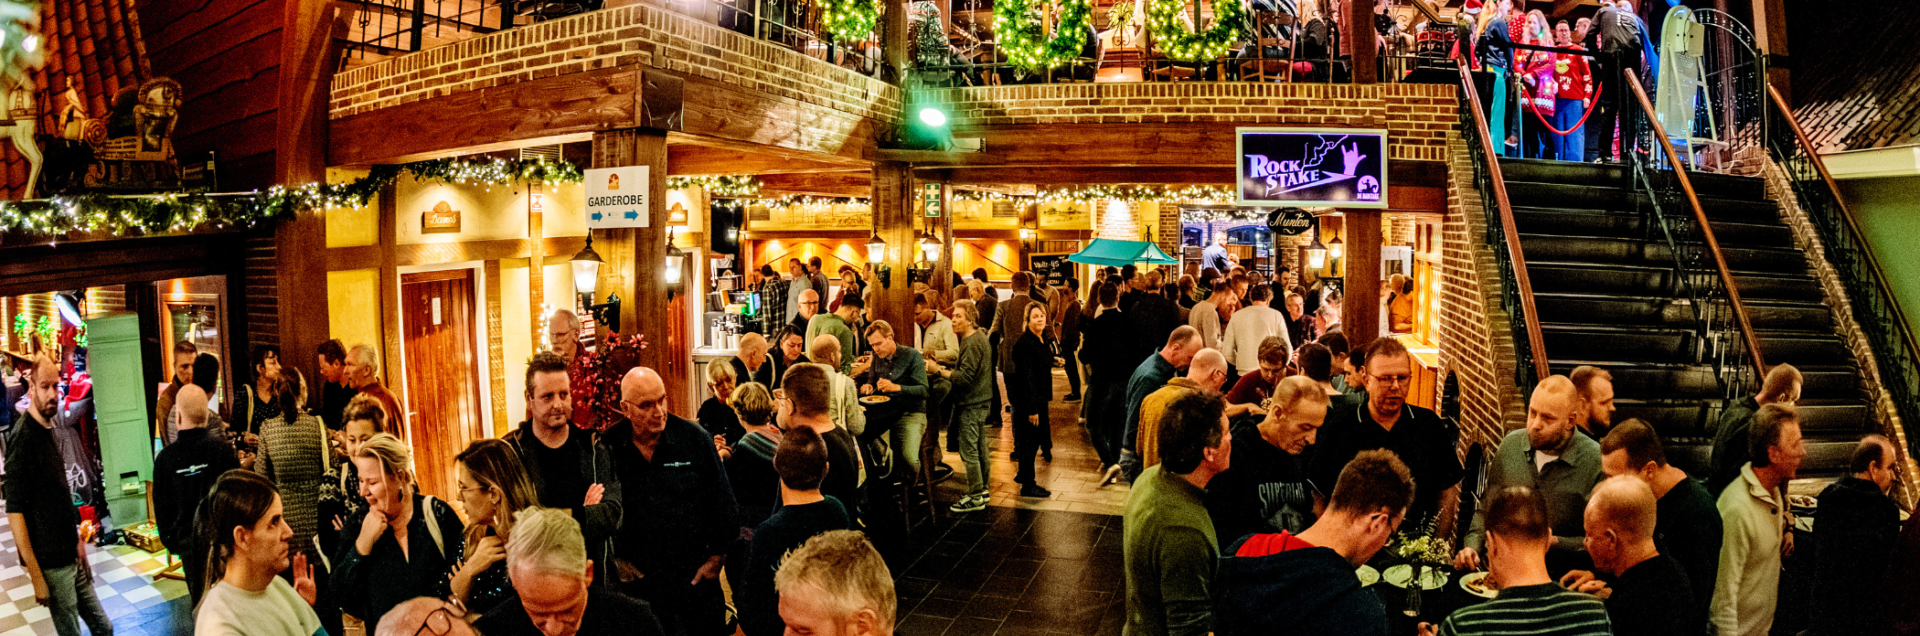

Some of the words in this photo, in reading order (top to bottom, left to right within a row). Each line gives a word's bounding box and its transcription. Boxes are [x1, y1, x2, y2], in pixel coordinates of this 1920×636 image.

[1244, 154, 1301, 178] ROCK
[1265, 169, 1320, 197] STAKE
[588, 194, 643, 207] GARDEROBE
[430, 213, 457, 224] Dames
